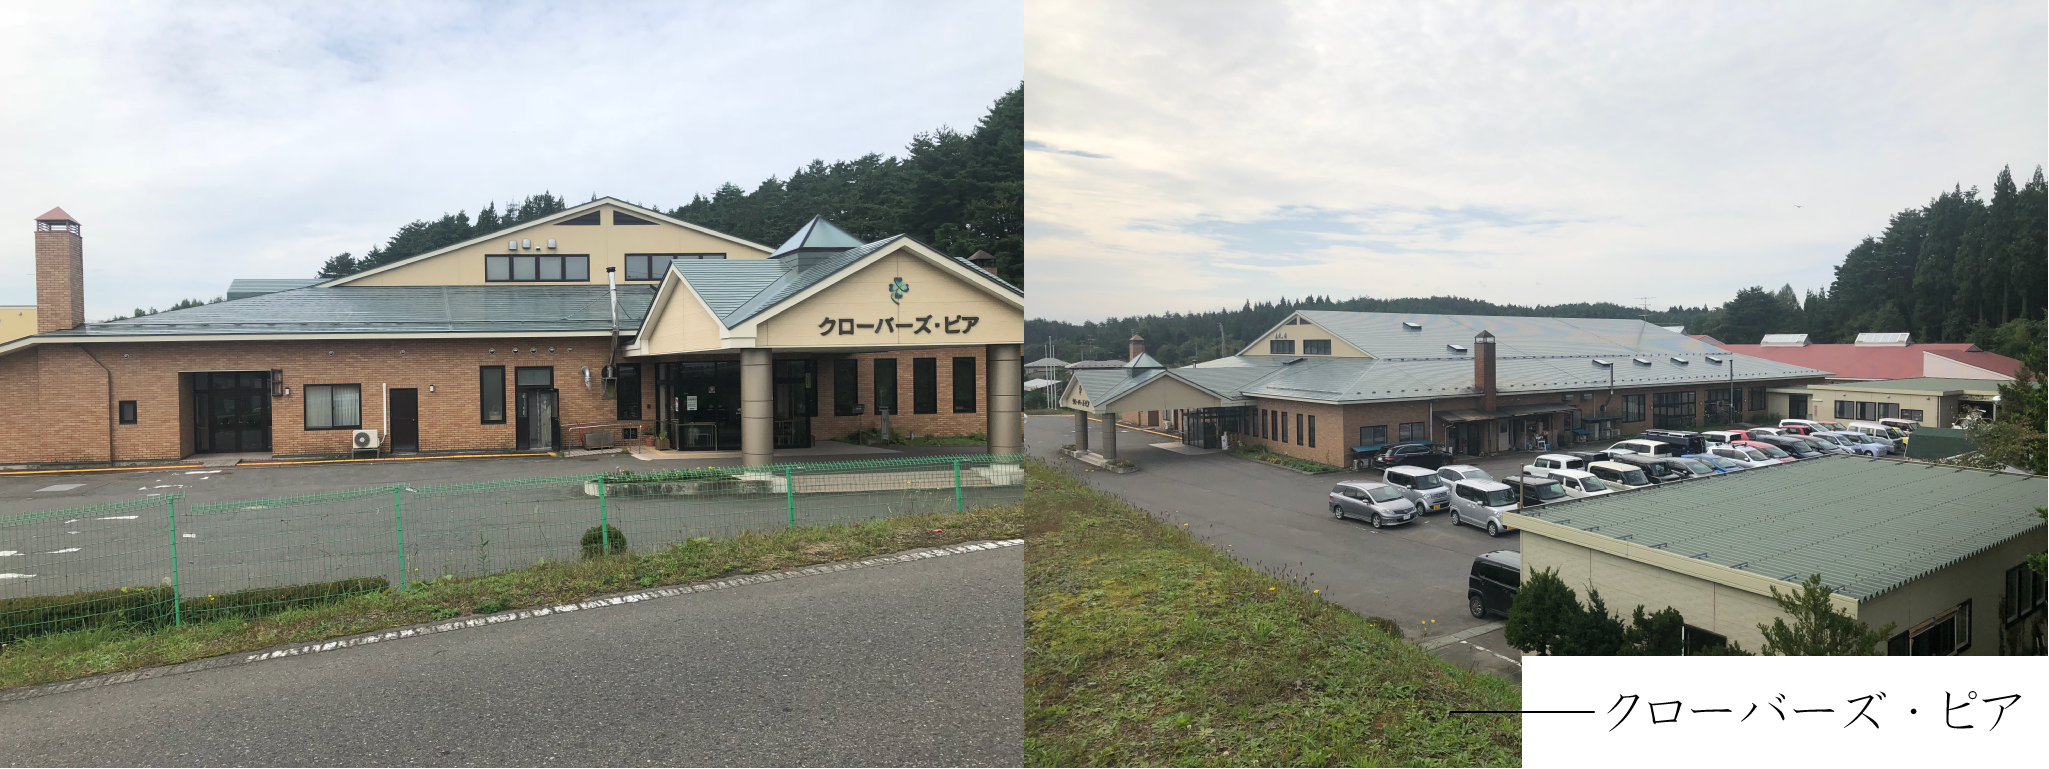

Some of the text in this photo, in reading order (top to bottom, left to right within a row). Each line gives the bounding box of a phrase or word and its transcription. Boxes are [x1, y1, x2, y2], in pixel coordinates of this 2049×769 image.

[818, 315, 979, 336] クローバーズ・ピア
